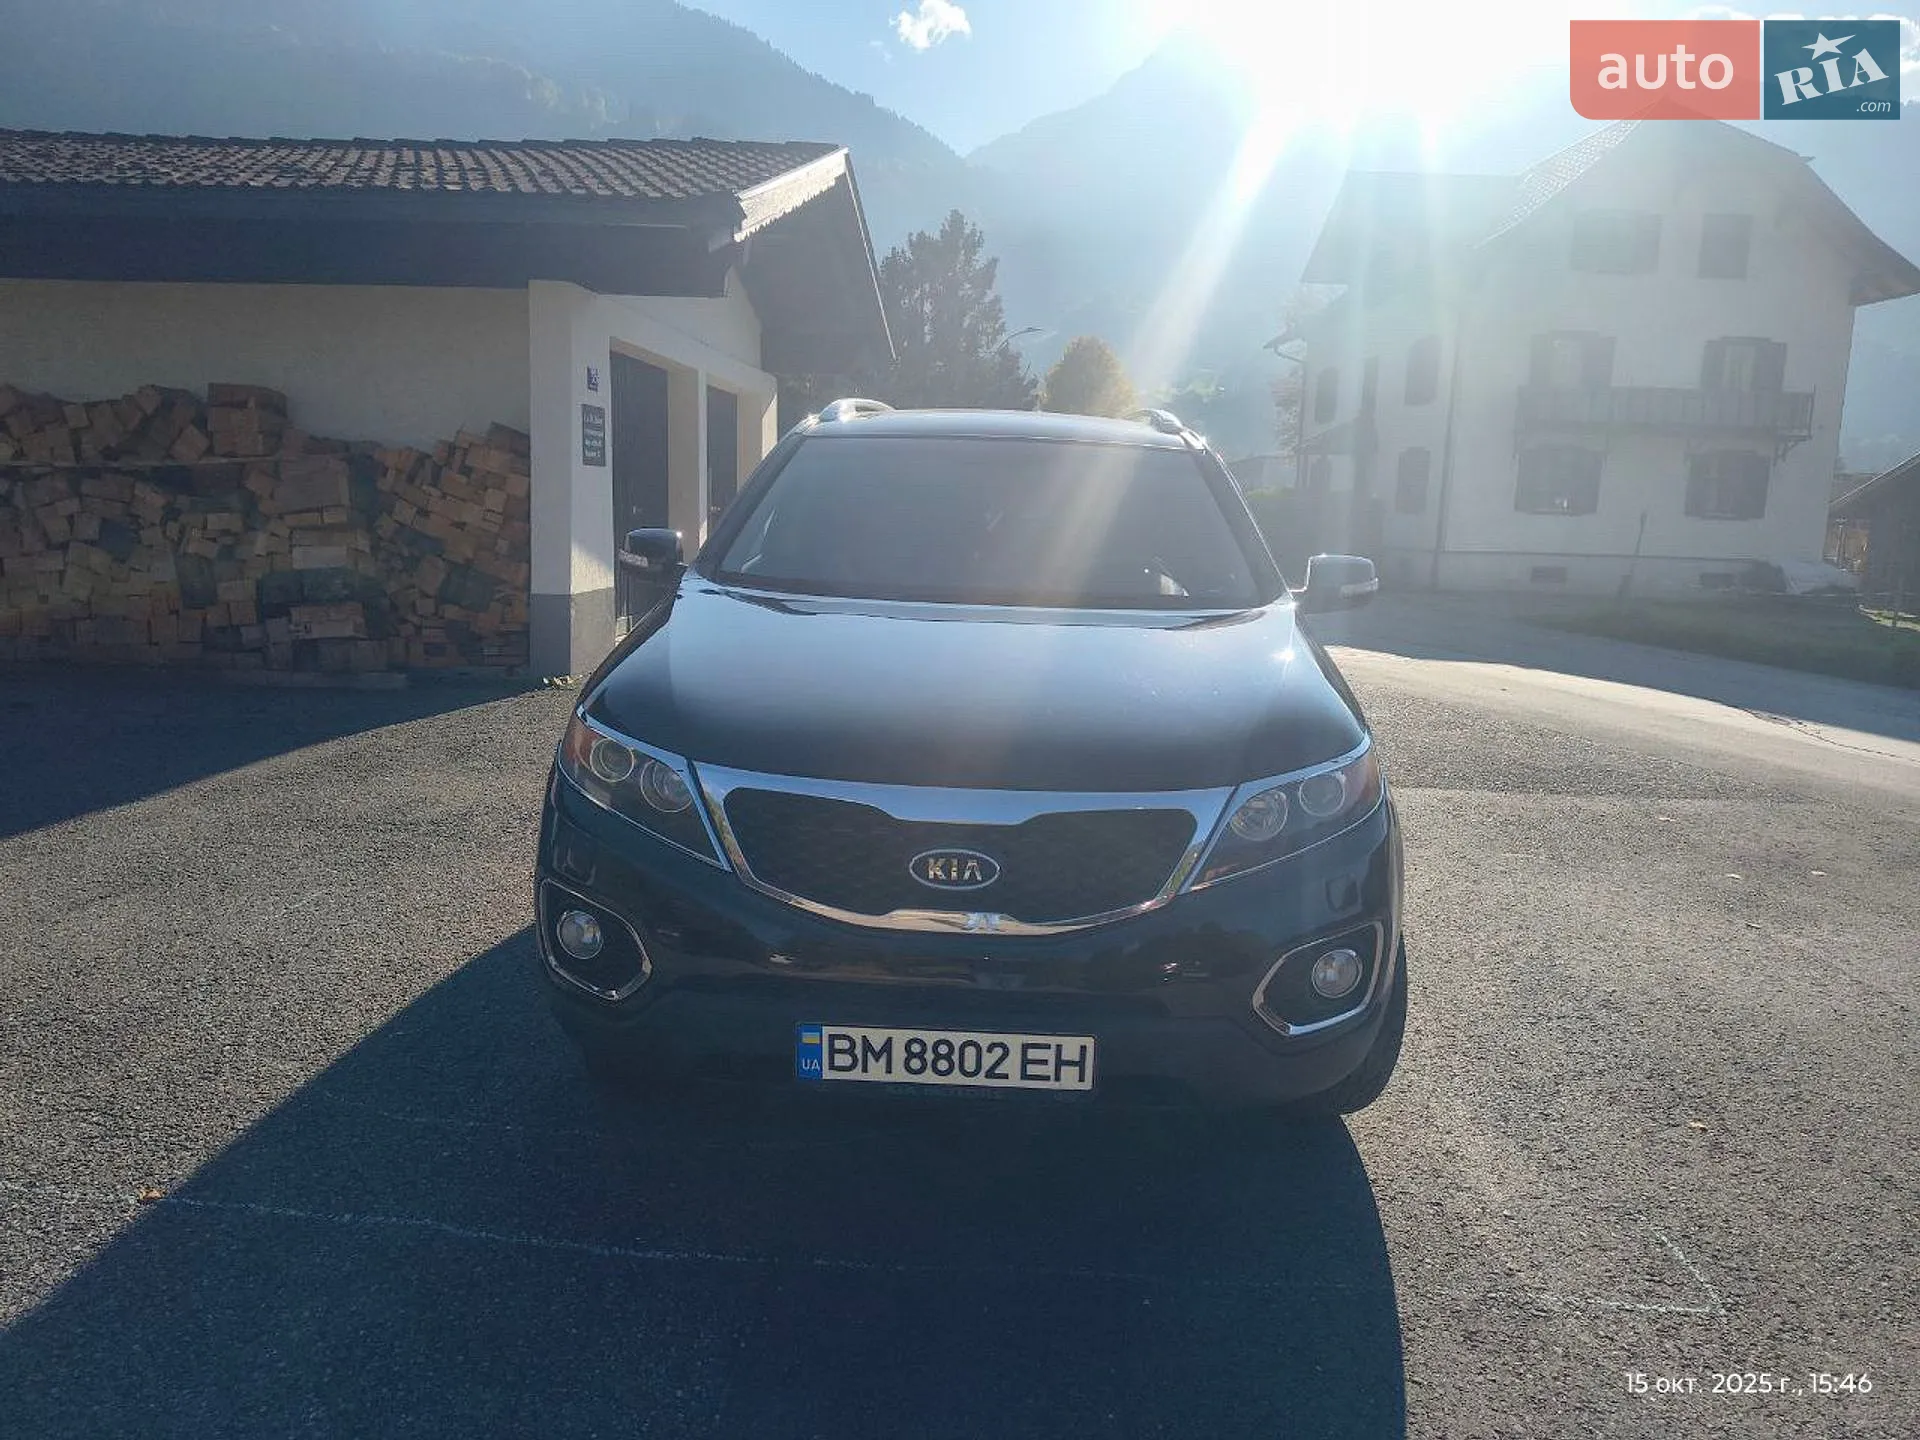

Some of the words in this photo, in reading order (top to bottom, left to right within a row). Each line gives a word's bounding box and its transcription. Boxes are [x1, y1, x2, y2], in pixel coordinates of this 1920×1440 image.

[928, 858, 983, 881] KIA
[802, 1060, 821, 1072] UA
[827, 1033, 894, 1074] BM
[903, 1037, 1010, 1080] 8802
[1020, 1042, 1088, 1083] EH
